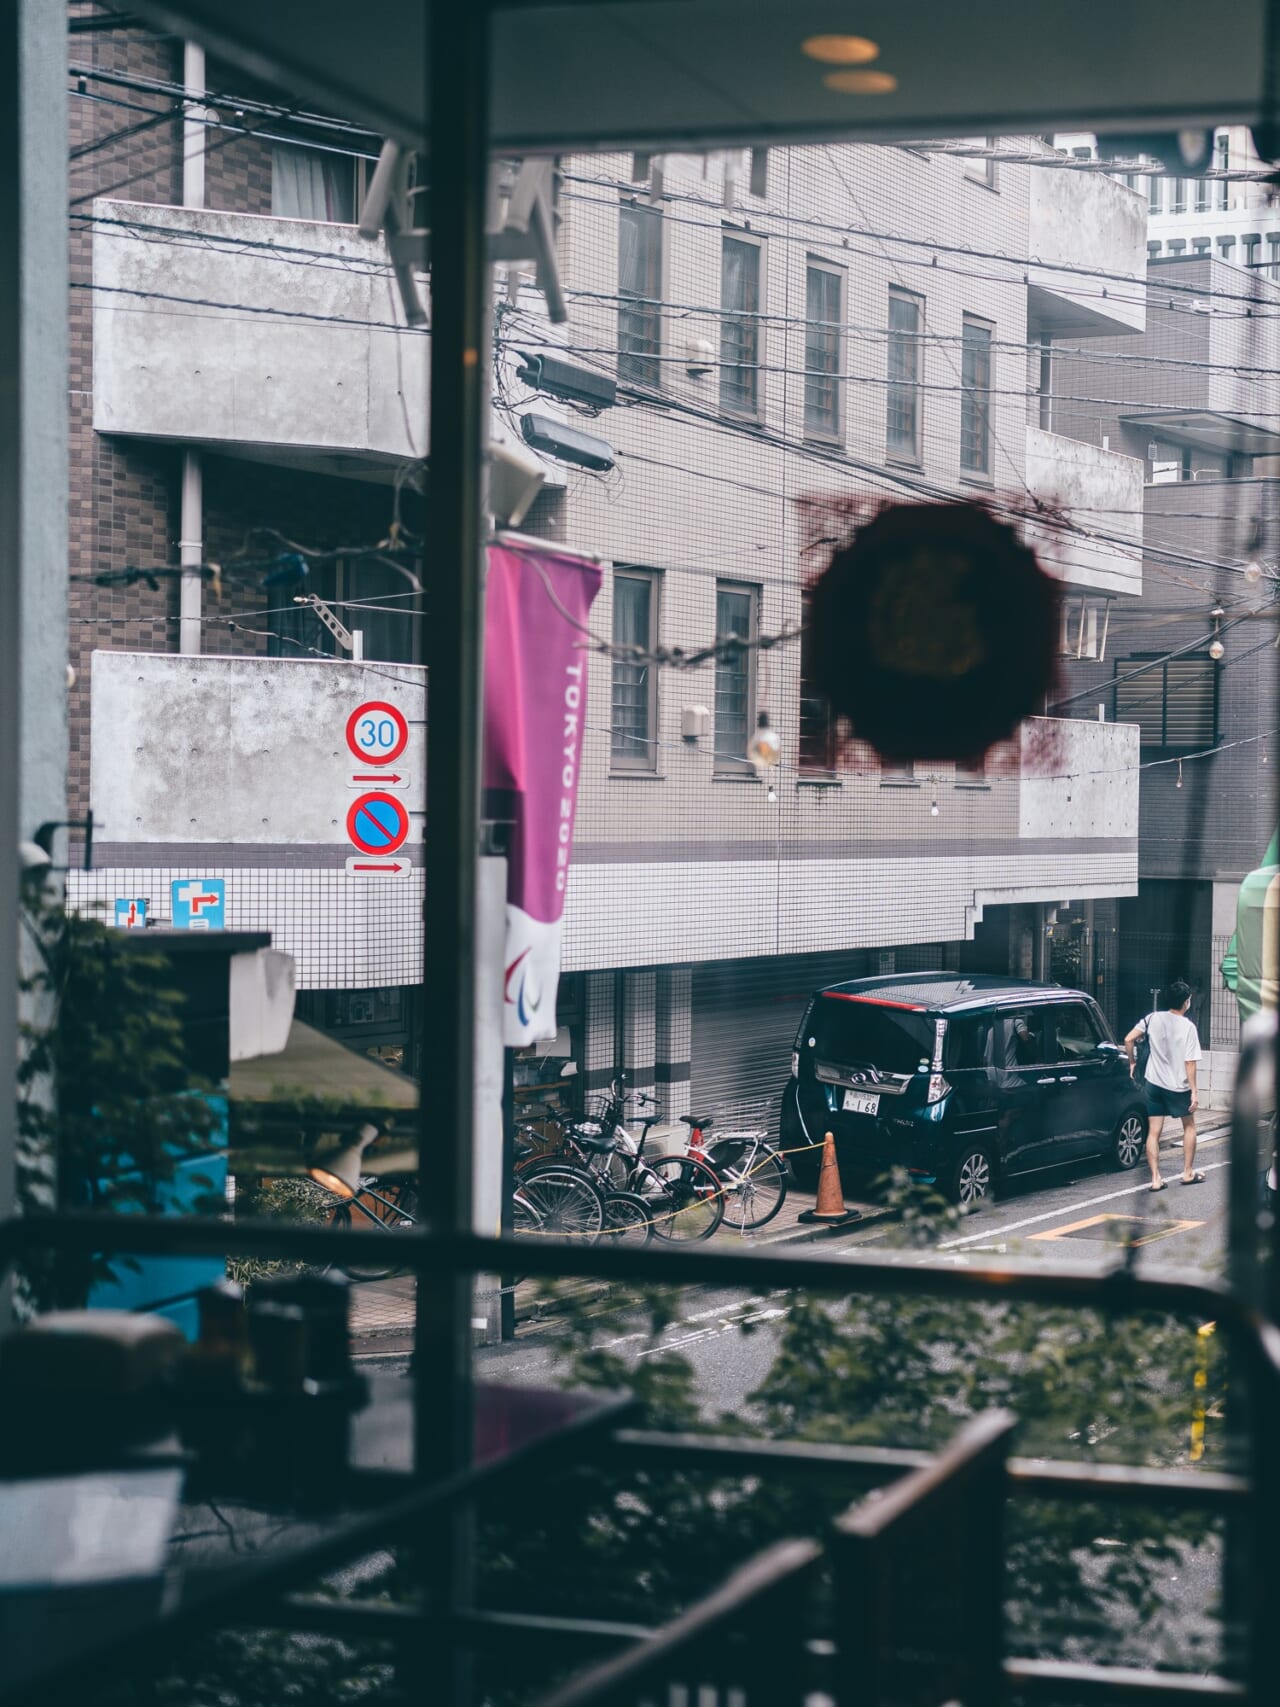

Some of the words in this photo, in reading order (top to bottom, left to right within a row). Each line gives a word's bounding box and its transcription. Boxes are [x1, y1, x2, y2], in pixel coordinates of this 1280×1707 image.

[360, 720, 394, 747] 30
[562, 661, 582, 789] TOKYO
[555, 798, 572, 892] 2020
